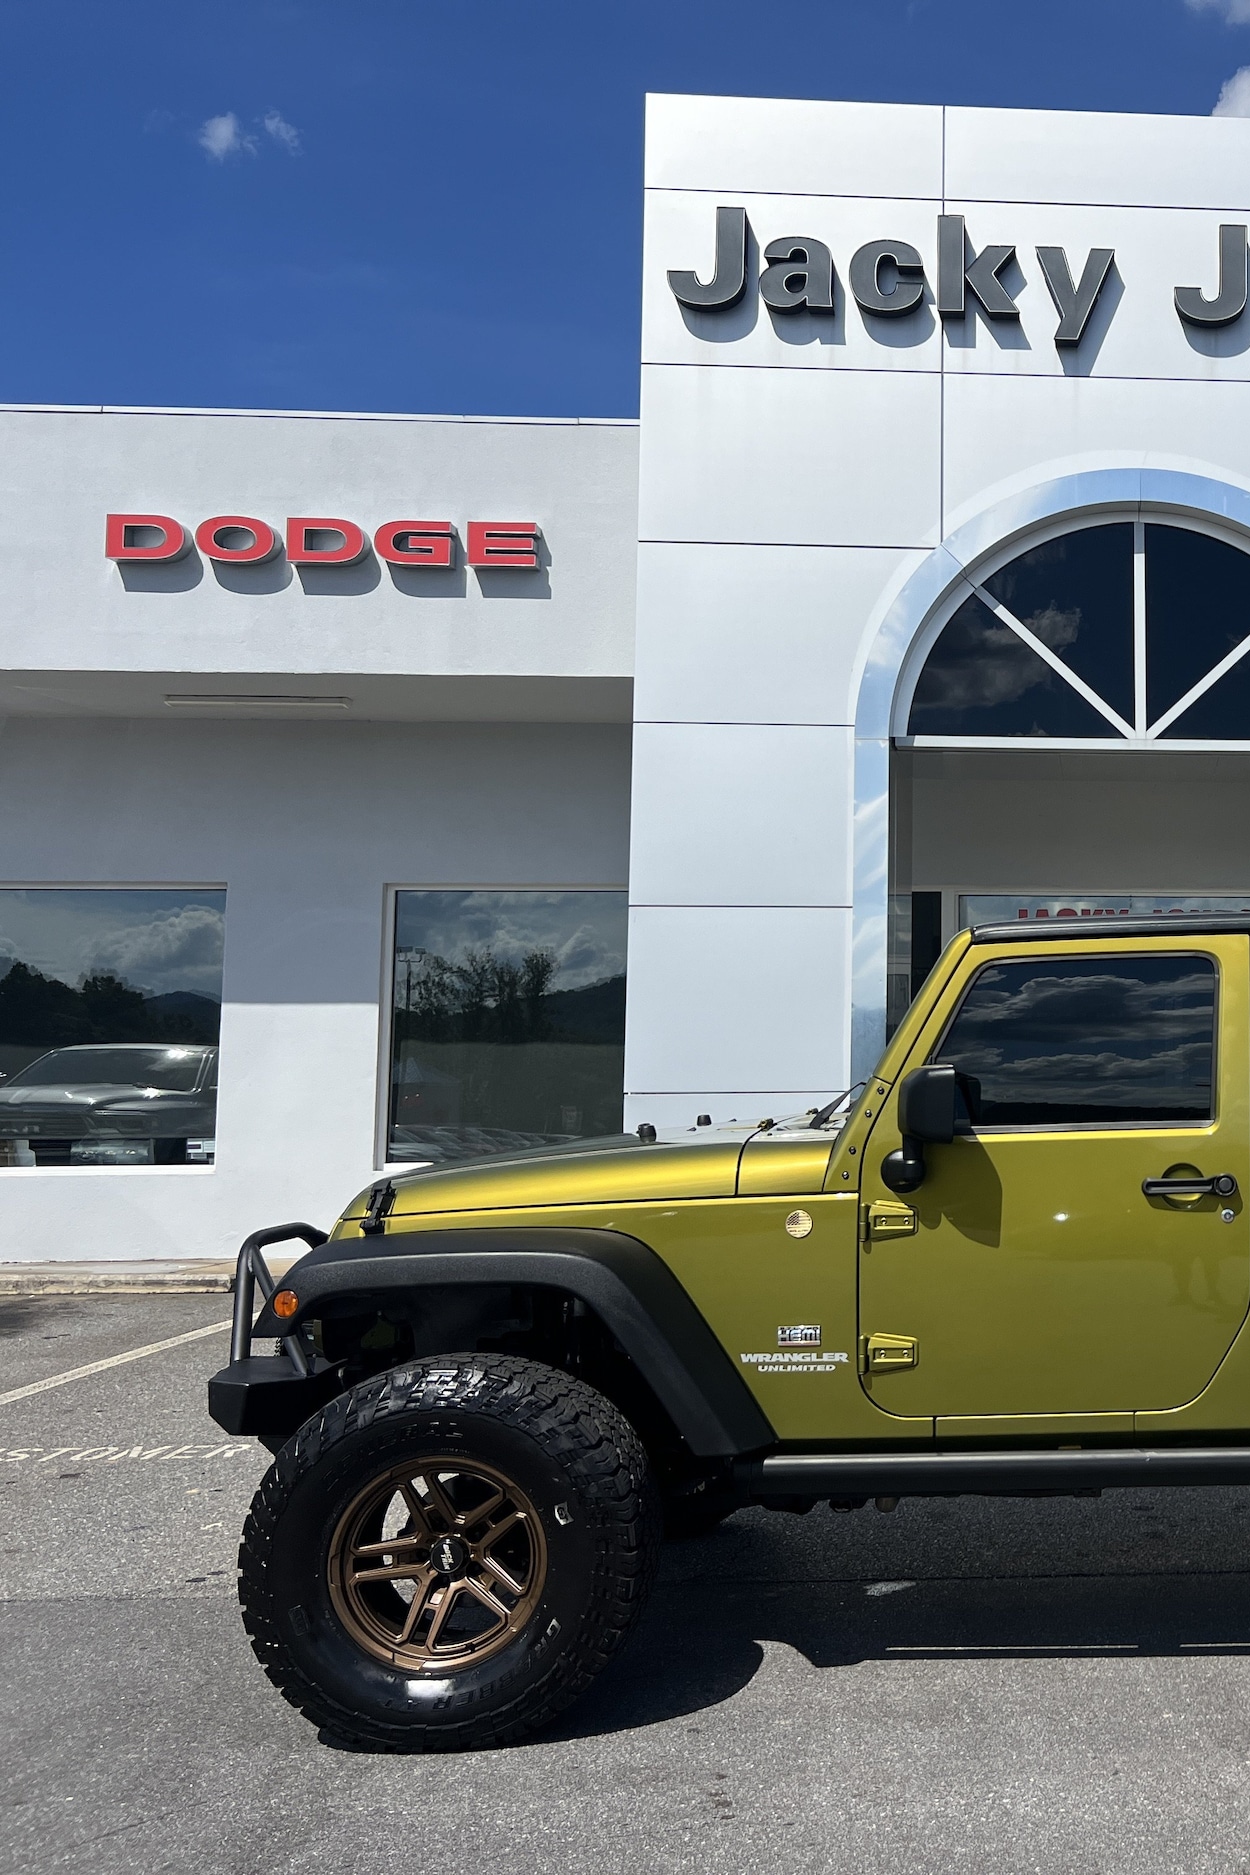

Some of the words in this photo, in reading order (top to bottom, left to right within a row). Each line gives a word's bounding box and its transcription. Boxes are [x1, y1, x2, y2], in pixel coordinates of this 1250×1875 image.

[667, 206, 1115, 347] Jacky
[105, 513, 543, 571] DODGE
[740, 1352, 849, 1363] WRANGLER
[757, 1364, 836, 1372] UNLIMITED
[0, 1443, 252, 1462] STOMER
